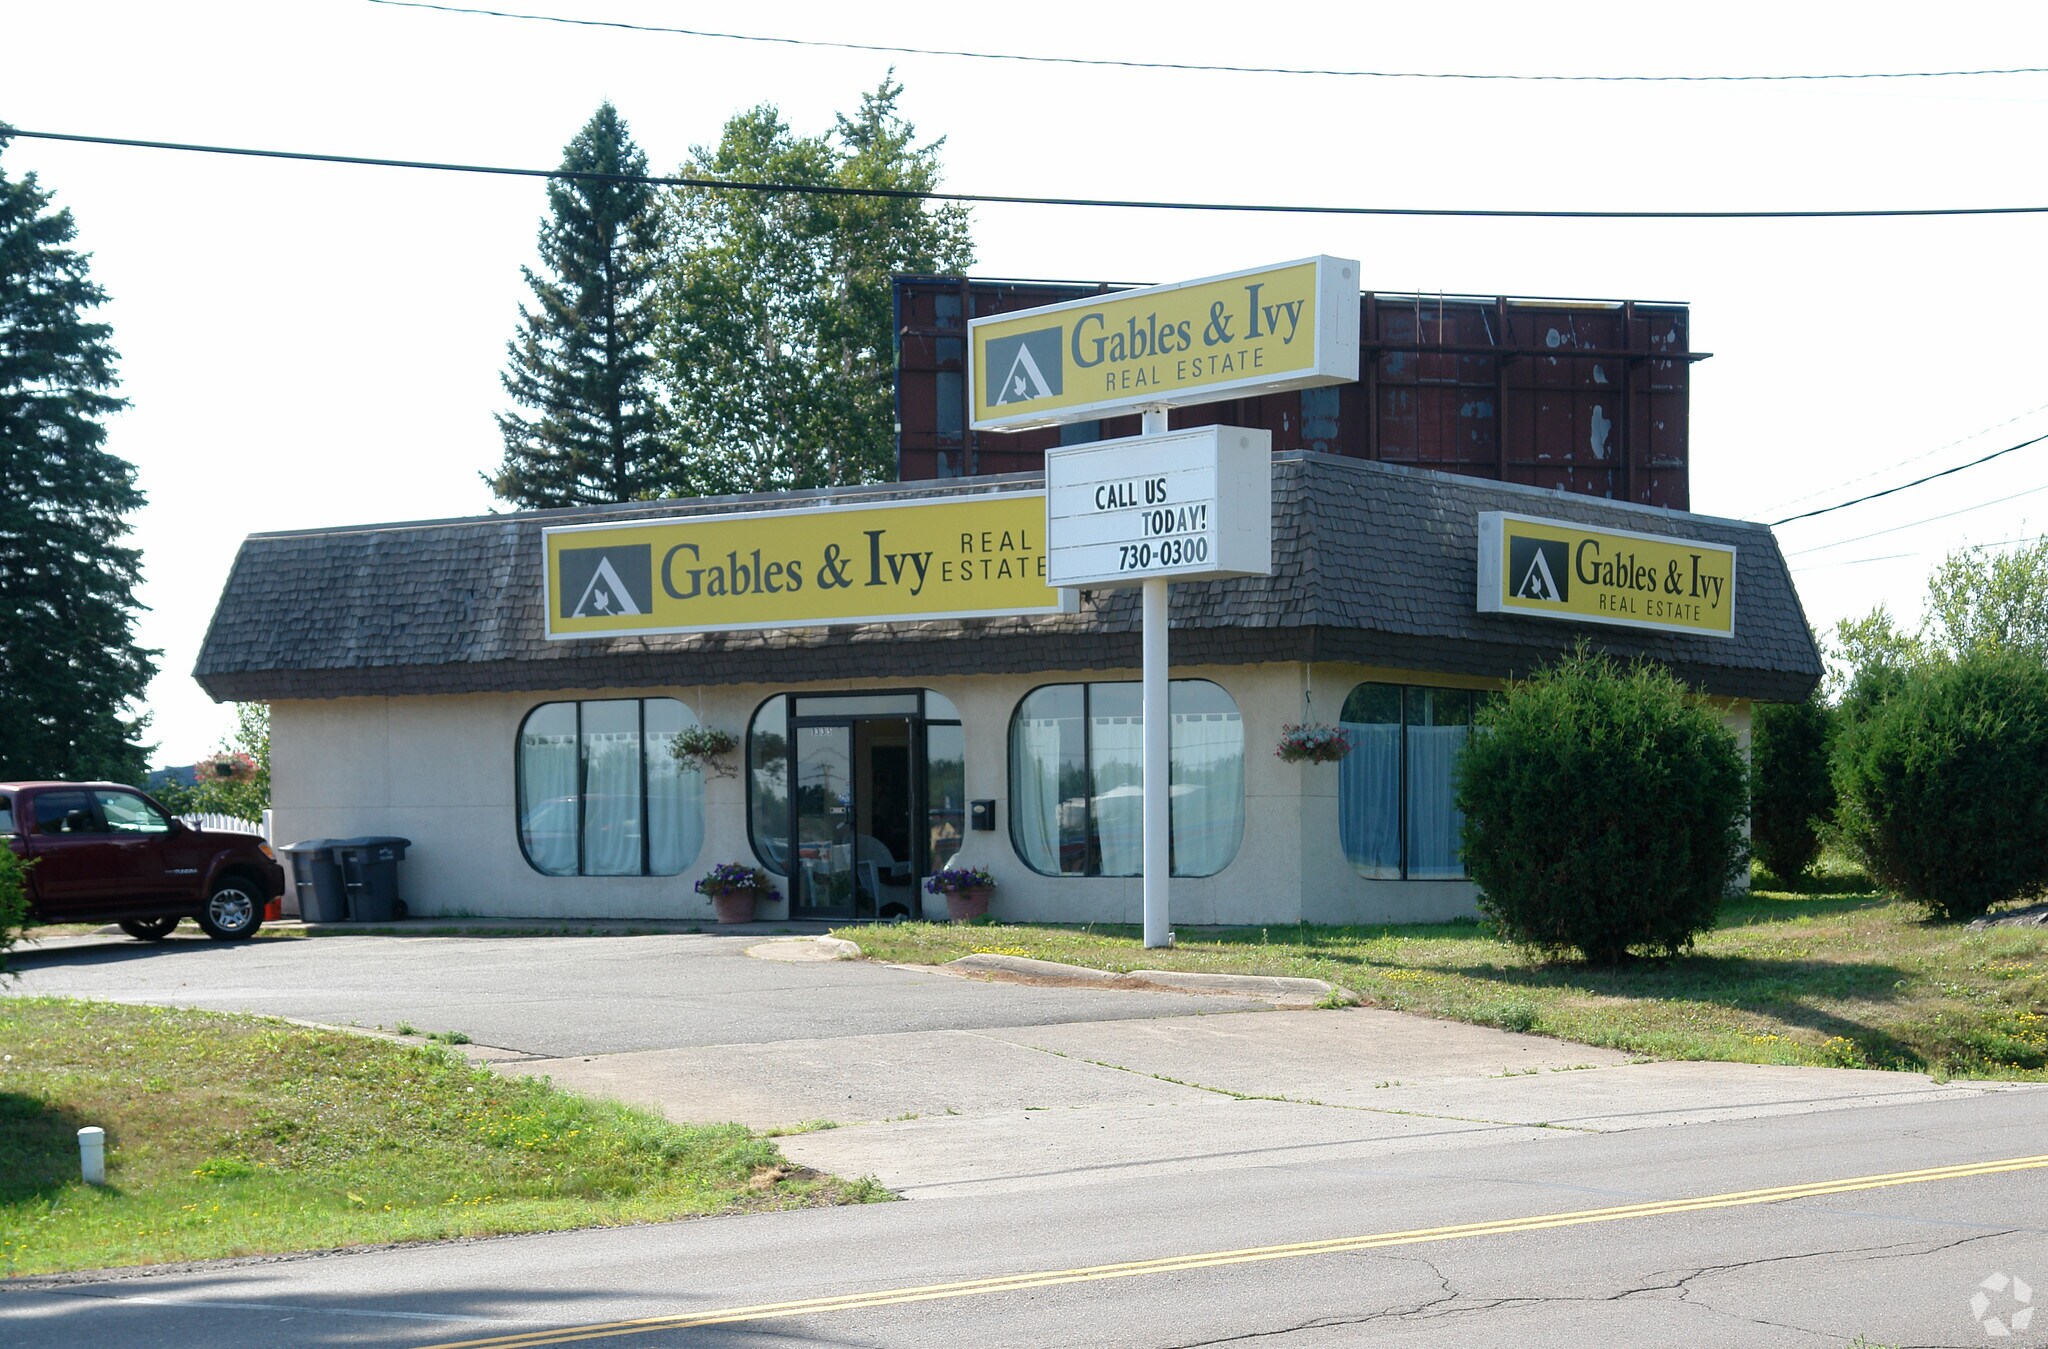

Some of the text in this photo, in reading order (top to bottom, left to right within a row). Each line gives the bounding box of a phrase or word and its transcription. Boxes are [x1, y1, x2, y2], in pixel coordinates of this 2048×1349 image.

[1071, 283, 1304, 368] Gables & Ivy
[1107, 347, 1263, 391] REAL ESTATE
[1095, 478, 1167, 510] CALL US
[1142, 505, 1207, 535] TODAY!
[961, 529, 1032, 553] REAL
[1119, 537, 1208, 570] 730-0300
[661, 529, 934, 599] Gables & Ivy
[942, 556, 1046, 582] ESTATE
[1575, 539, 1725, 609] Gables & Ivy
[1599, 593, 1701, 622] REAL ESTATE
